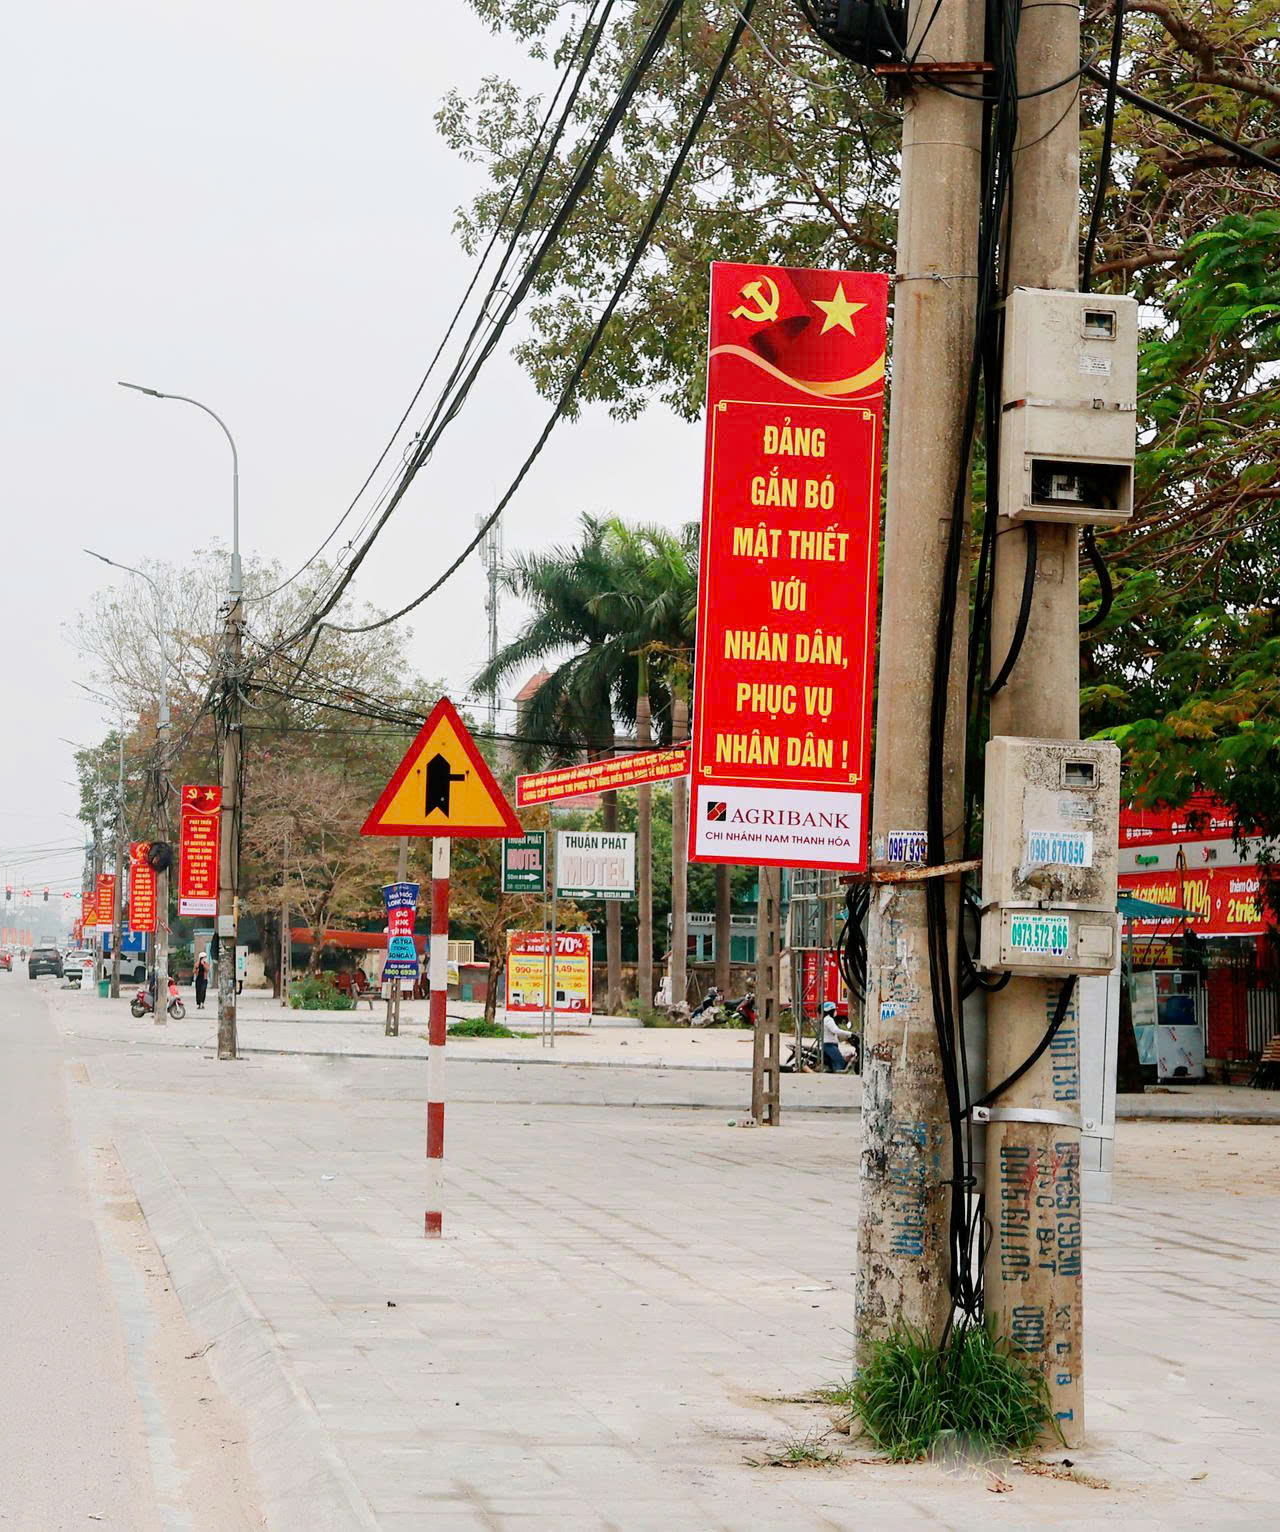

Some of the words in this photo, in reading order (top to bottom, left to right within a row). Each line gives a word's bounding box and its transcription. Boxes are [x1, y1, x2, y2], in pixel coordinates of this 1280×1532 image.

[763, 416, 826, 457] ĐẢNG
[751, 466, 798, 507] GẮN
[805, 474, 835, 509] BÓ
[732, 522, 782, 564] MẬT
[788, 523, 850, 562] THIẾT
[771, 576, 807, 611] VỚI
[724, 626, 788, 661] NHÂN
[795, 629, 848, 669] DÂN,
[736, 682, 796, 720] PHỤC
[804, 686, 833, 723] VỤ
[716, 729, 780, 765] NHÂN
[786, 732, 833, 768] DÂN
[730, 808, 850, 830] AGRIBANK
[565, 834, 598, 852] THUẬN
[601, 835, 628, 850] PHÁT
[705, 831, 723, 840] CHI
[726, 831, 763, 843] NHÁNH
[765, 834, 790, 844] NAM
[792, 835, 825, 845] THANH
[828, 834, 851, 847] HÓA
[507, 849, 542, 870] MOTEL
[563, 855, 629, 887] MOTEL
[1012, 923, 1068, 948] 0973.572.366
